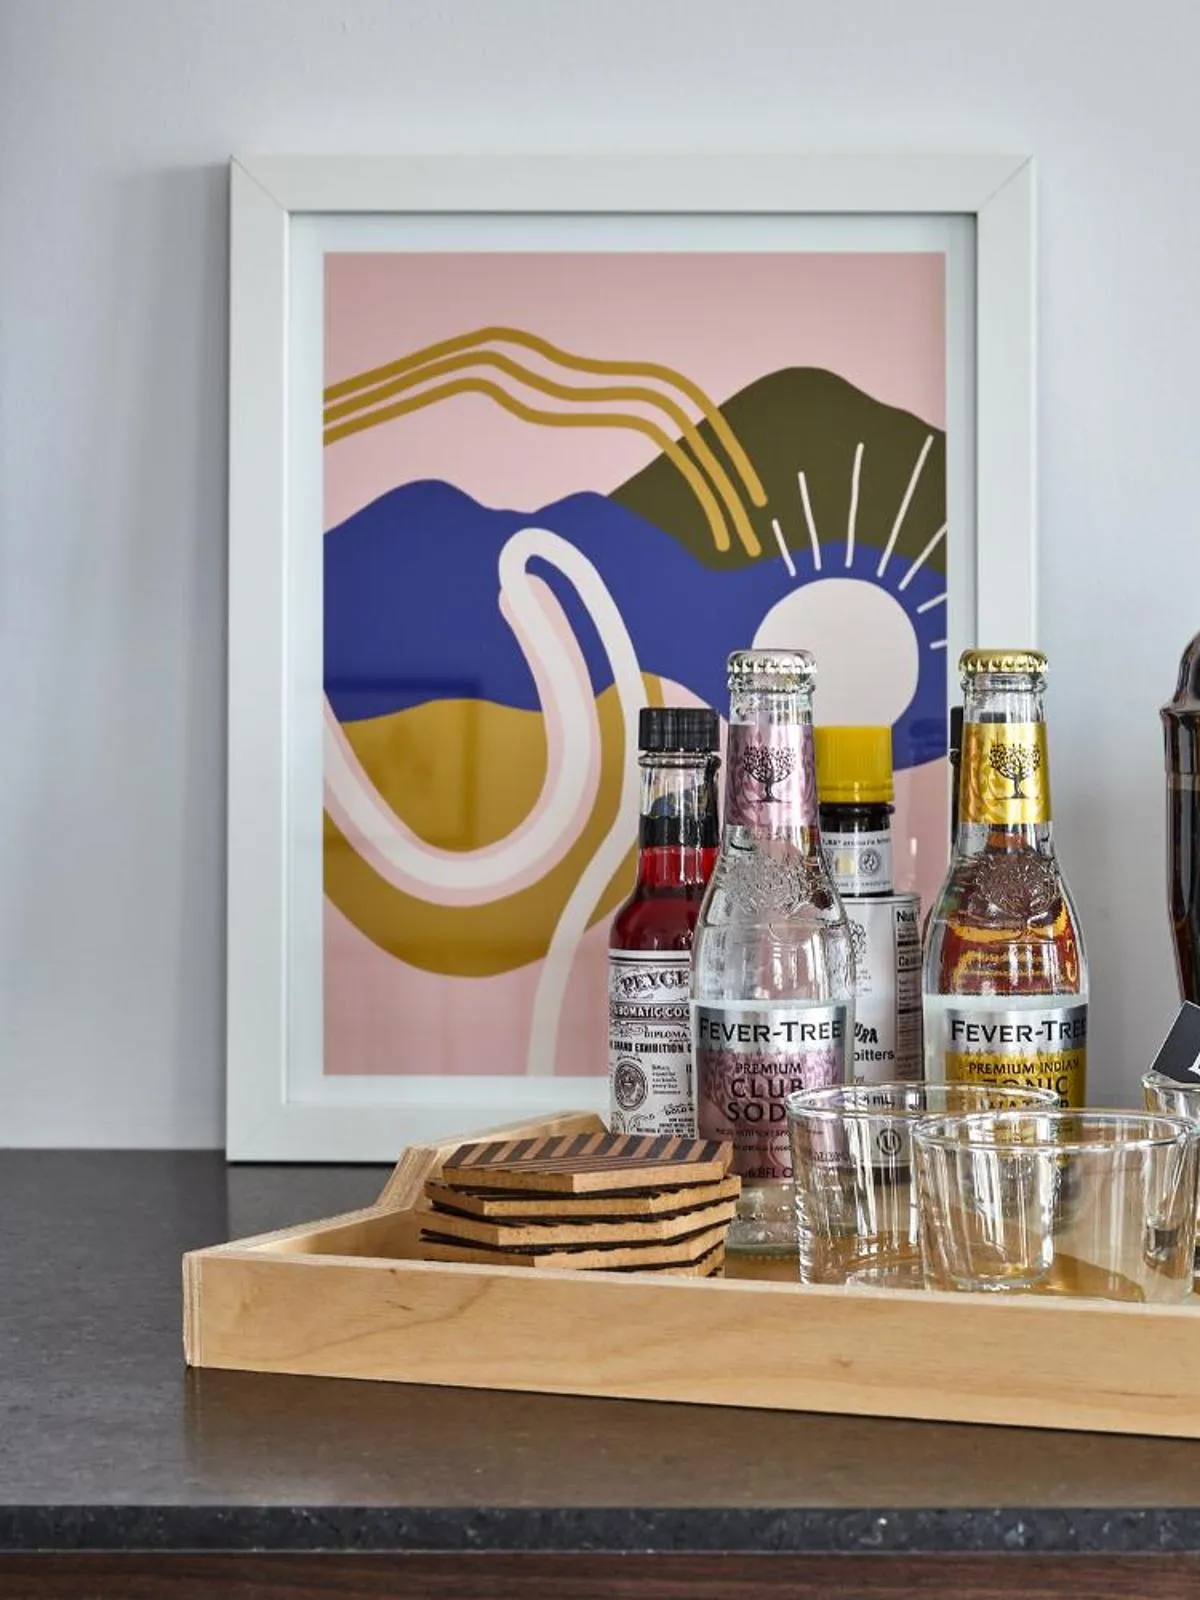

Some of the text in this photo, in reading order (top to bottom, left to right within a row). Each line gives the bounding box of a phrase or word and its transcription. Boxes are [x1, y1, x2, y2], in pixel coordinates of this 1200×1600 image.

[700, 1016, 842, 1043] FEVER-TREE
[951, 1018, 1087, 1043] FEVER-TREE
[735, 1062, 803, 1075] PREMIUM
[968, 1057, 1080, 1075] PREMIUM INDIAN
[731, 1078, 804, 1099] CLUB
[727, 1101, 787, 1123] SOD
